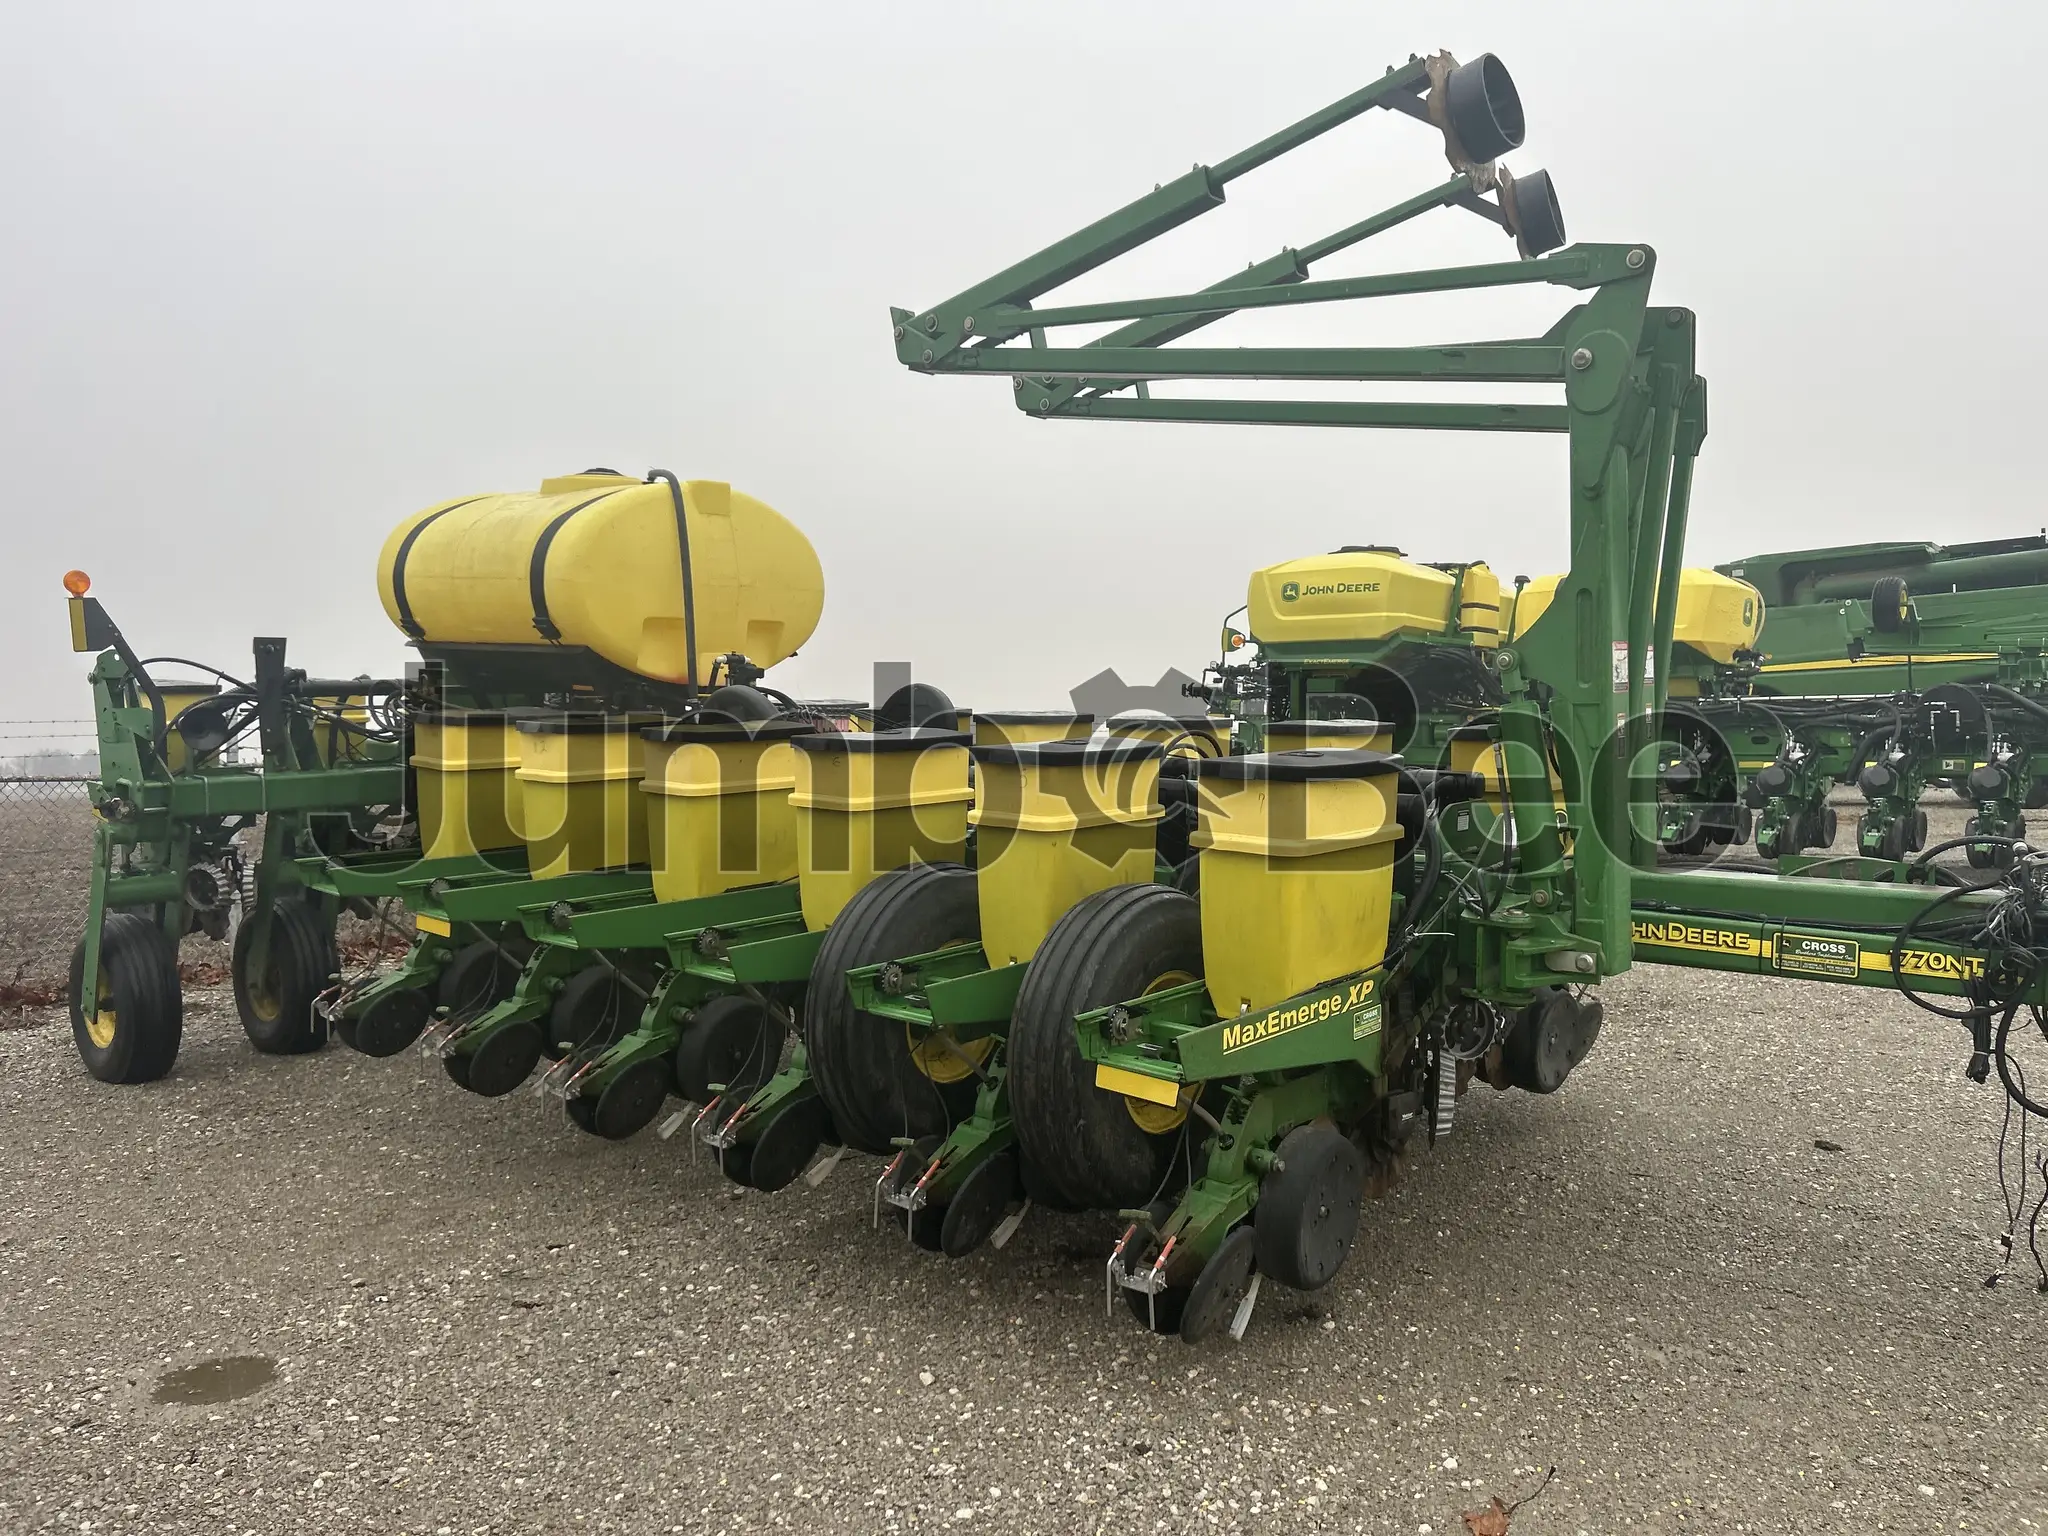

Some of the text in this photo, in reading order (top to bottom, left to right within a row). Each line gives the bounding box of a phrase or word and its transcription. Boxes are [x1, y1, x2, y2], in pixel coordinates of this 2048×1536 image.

[1302, 583, 1380, 596] JOHN DEERE
[1668, 922, 1750, 949] DEERE
[1801, 940, 1846, 954] CROSS
[1889, 949, 1985, 975] 770NT
[1222, 979, 1375, 1051] MaxEmerge XP
